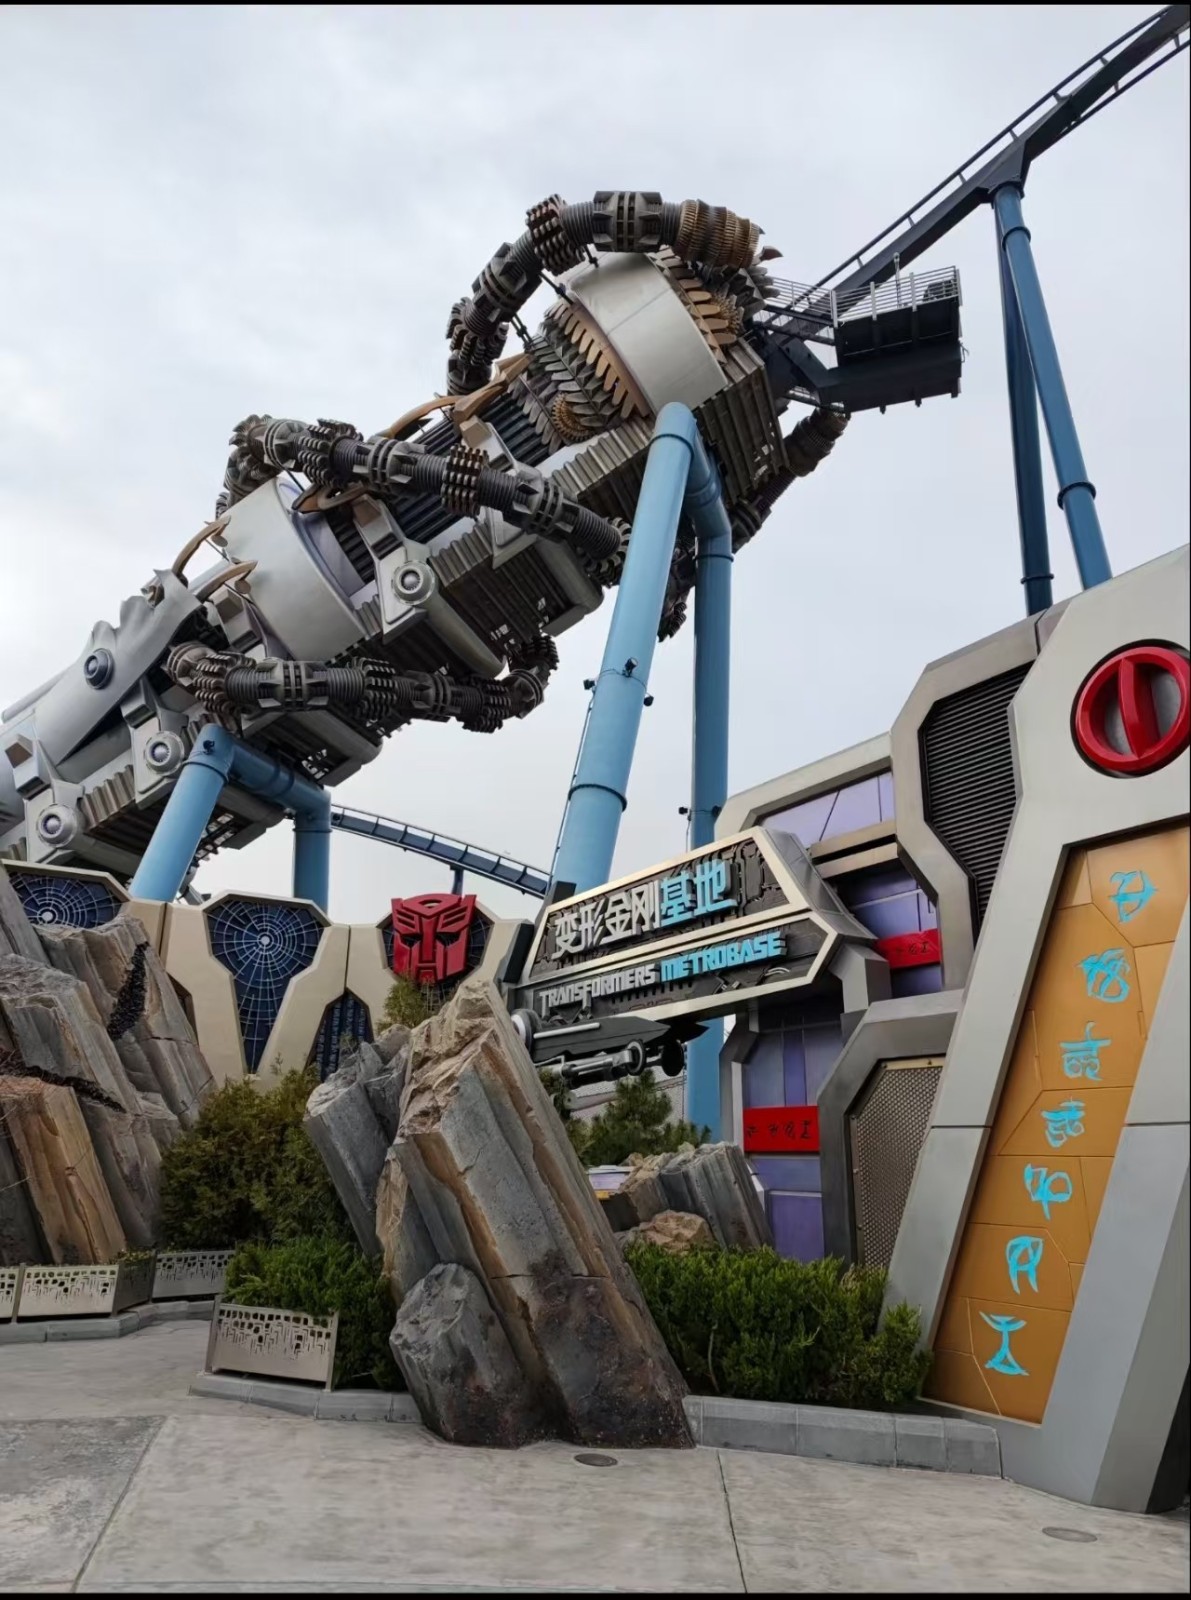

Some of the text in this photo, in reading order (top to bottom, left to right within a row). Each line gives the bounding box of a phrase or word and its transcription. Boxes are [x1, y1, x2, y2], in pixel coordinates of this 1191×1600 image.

[552, 859, 737, 959] 变形金刚基地
[539, 930, 786, 1016] TRANSFORMERS METROBASE
